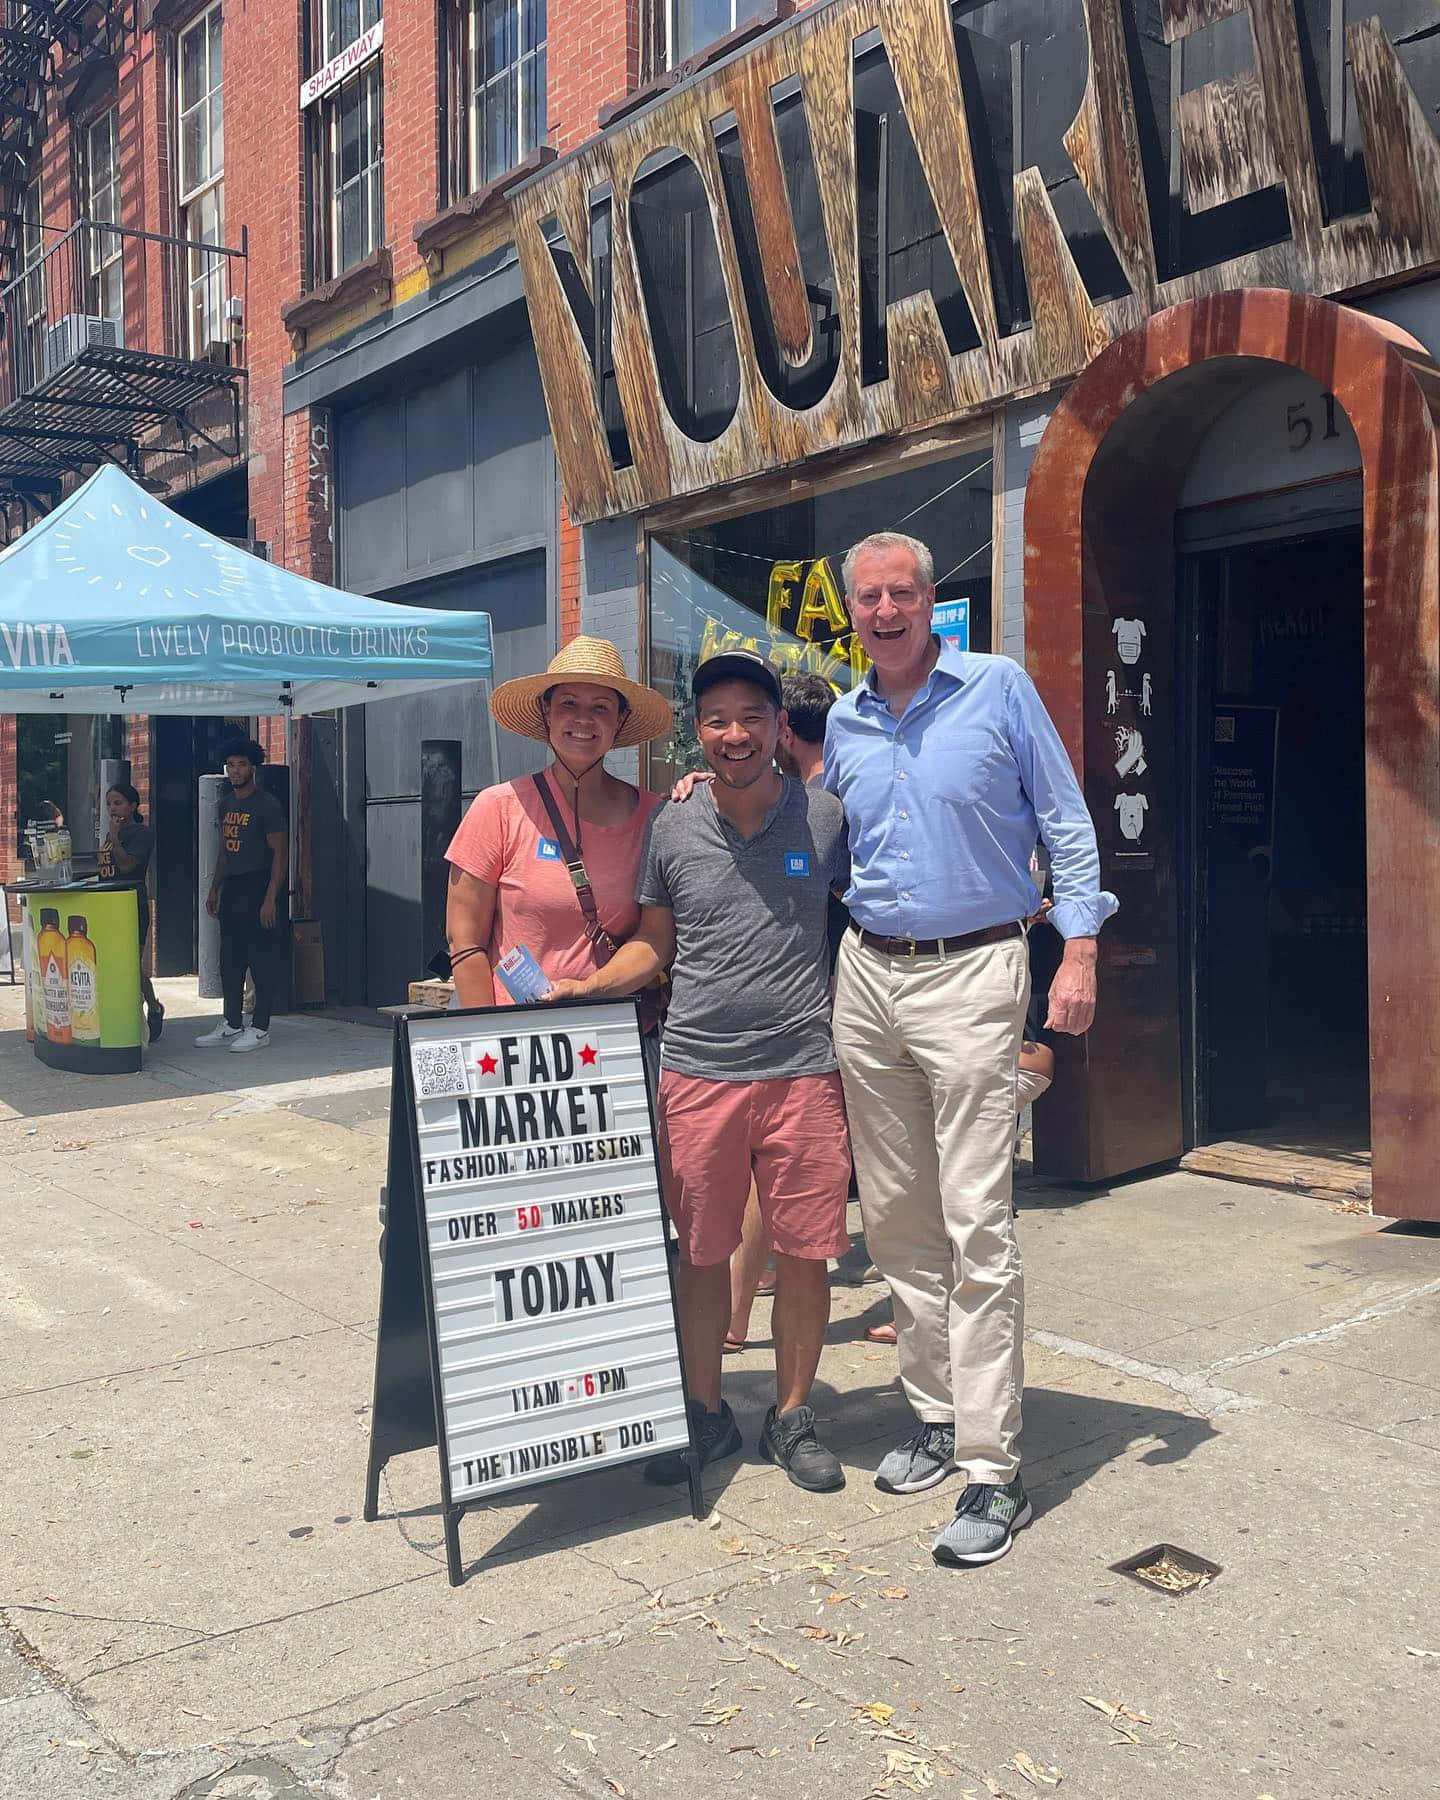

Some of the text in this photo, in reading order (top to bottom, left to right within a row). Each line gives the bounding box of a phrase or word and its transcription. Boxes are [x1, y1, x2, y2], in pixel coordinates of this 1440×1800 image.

[308, 29, 376, 97] SHAFTWAY
[1286, 391, 1340, 453] 51
[0, 622, 429, 671] VITA LIVELY PROBIOTIC DRINKS
[499, 1033, 574, 1087] FAD
[458, 1084, 609, 1149] MARKET
[447, 1193, 624, 1241] OVER 50 MAKERS
[494, 1251, 616, 1322] TODAY
[511, 1381, 560, 1413] 11AM
[463, 1420, 654, 1486] THE INVISIBLE DOG
